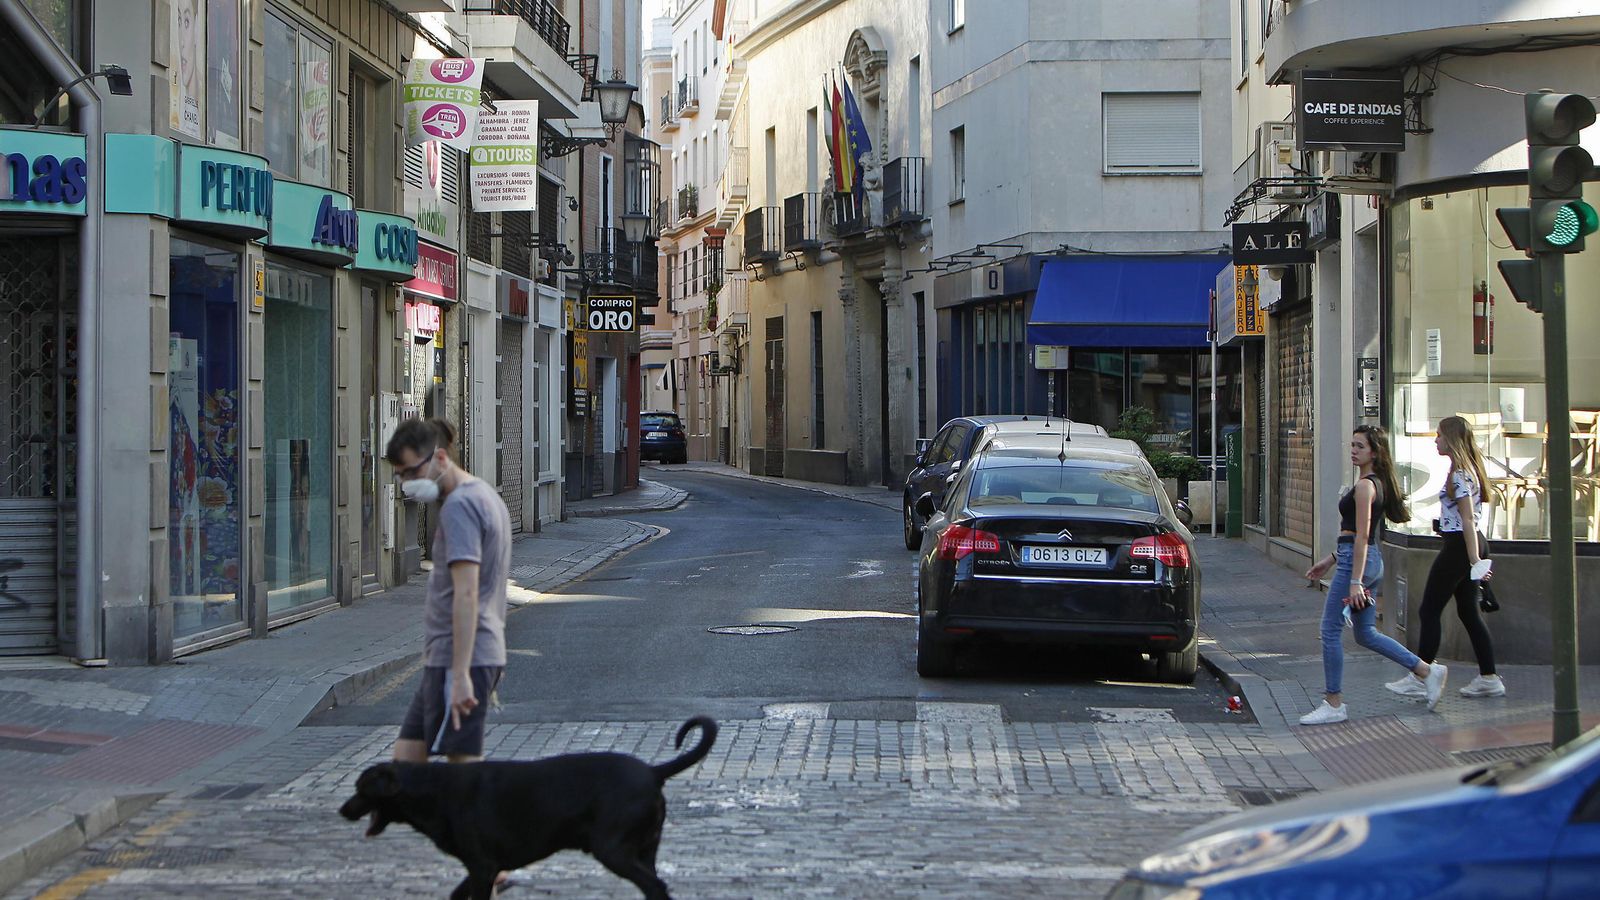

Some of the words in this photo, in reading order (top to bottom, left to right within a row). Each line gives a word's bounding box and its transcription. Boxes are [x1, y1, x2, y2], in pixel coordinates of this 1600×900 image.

[410, 86, 474, 102] TICKETS
[1304, 102, 1337, 114] CAFE
[1339, 103, 1356, 115] DE
[1357, 103, 1402, 116] INDIAS
[440, 113, 457, 122] TREN
[590, 299, 633, 308] COMPRO
[589, 310, 633, 331] ORO
[1033, 548, 1070, 562] 0613
[1075, 549, 1102, 563] GLZ
